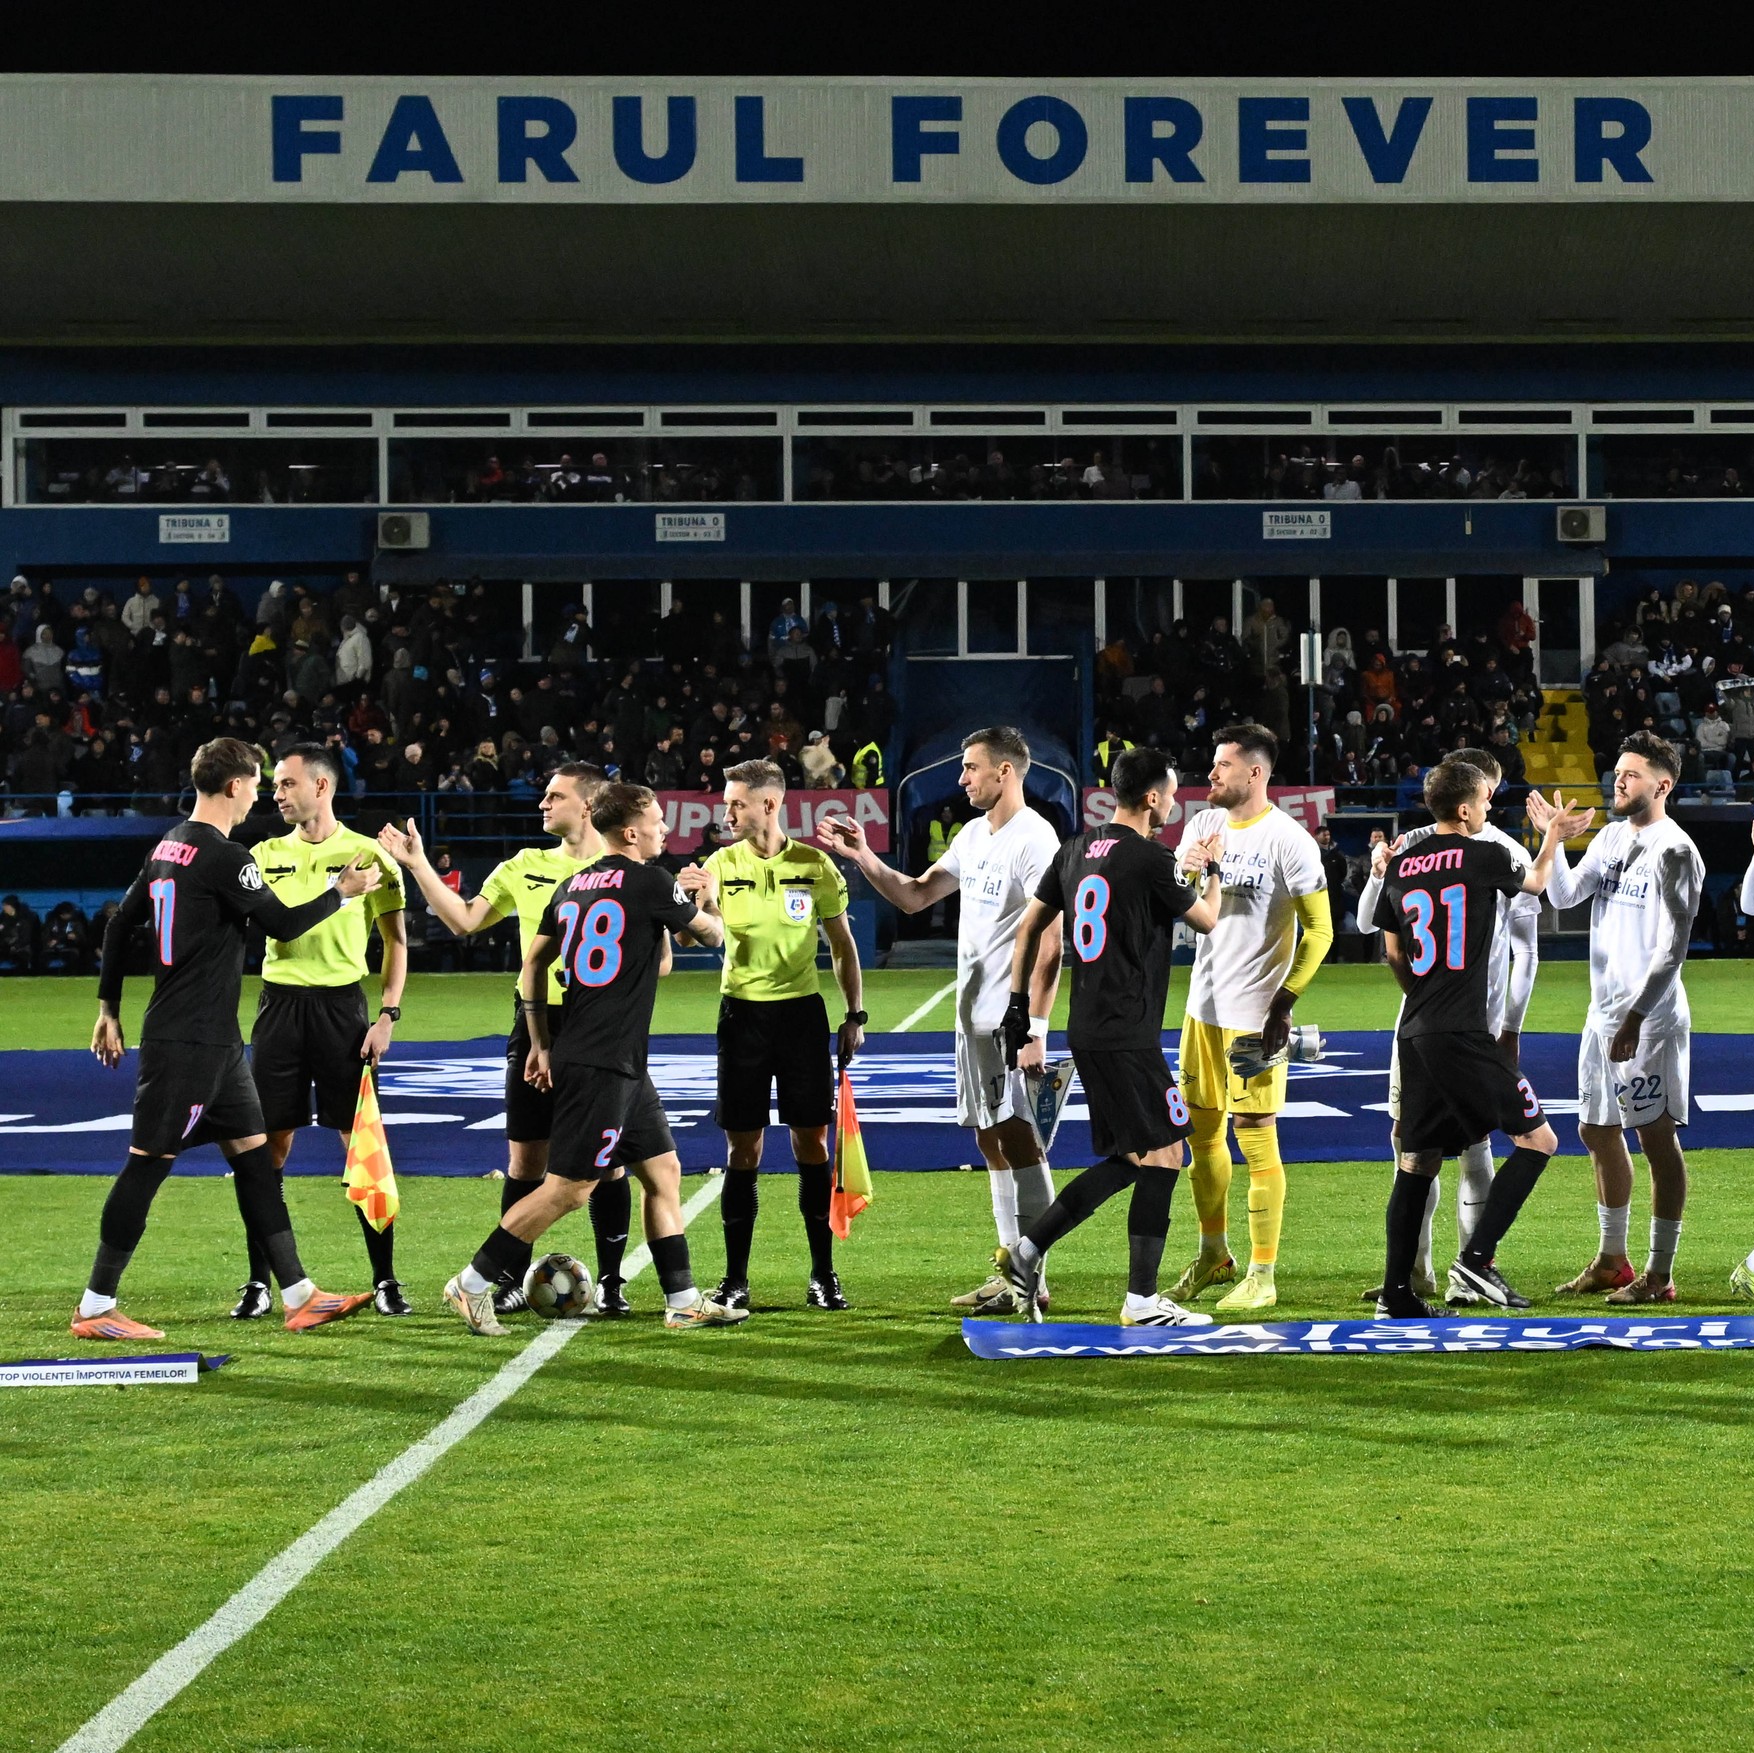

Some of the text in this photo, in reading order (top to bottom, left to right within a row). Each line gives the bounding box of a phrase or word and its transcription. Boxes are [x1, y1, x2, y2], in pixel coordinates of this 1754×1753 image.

[271, 95, 1655, 185] FARUL FOREVER
[165, 518, 210, 529] TRIBUNA
[661, 517, 706, 527] TRIBUNA
[1268, 514, 1313, 525] TRIBUNA
[1085, 838, 1121, 859] SUT
[1247, 852, 1267, 868] de
[1398, 848, 1464, 878] CISOTTI
[1073, 874, 1111, 963] 8
[1401, 883, 1467, 977] 31
[1630, 1074, 1663, 1101] 22
[1166, 1086, 1190, 1127] 8
[1168, 1321, 1730, 1342] Alături
[22, 1371, 74, 1383] VIOLENȚEI
[76, 1368, 131, 1380] ÎMPOTRIVA
[134, 1368, 187, 1380] FEMEILOR!
